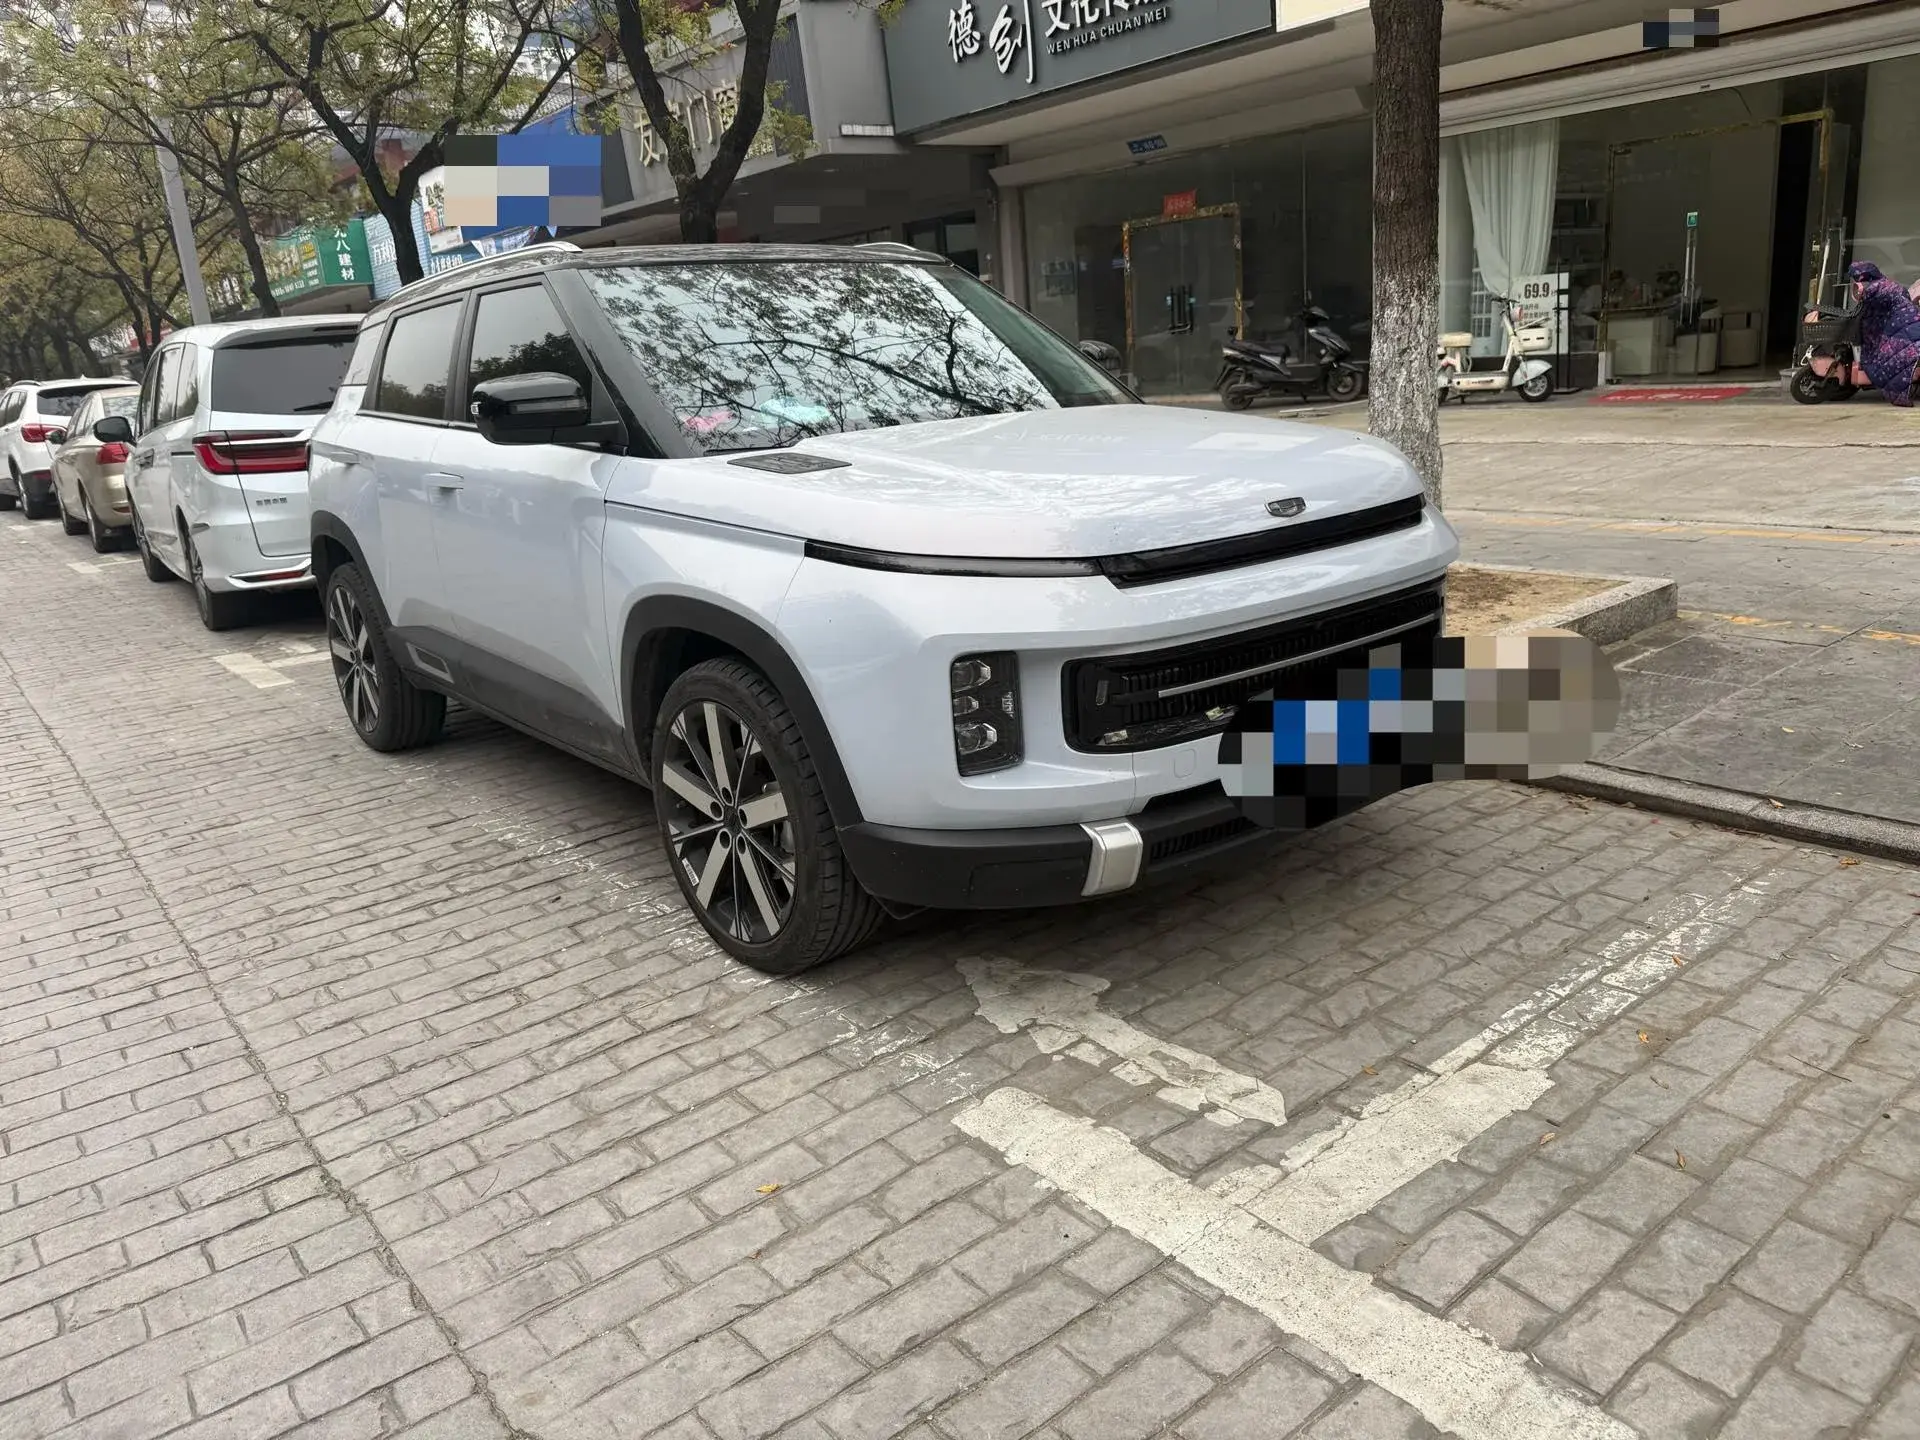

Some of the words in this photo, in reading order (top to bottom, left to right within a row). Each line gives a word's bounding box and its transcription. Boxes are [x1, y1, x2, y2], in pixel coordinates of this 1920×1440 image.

[1046, 39, 1071, 55] WEN
[1073, 31, 1097, 47] HUA
[1100, 16, 1142, 38] CHUAN
[1144, 6, 1167, 24] MEI
[1524, 282, 1550, 299] 69.9
